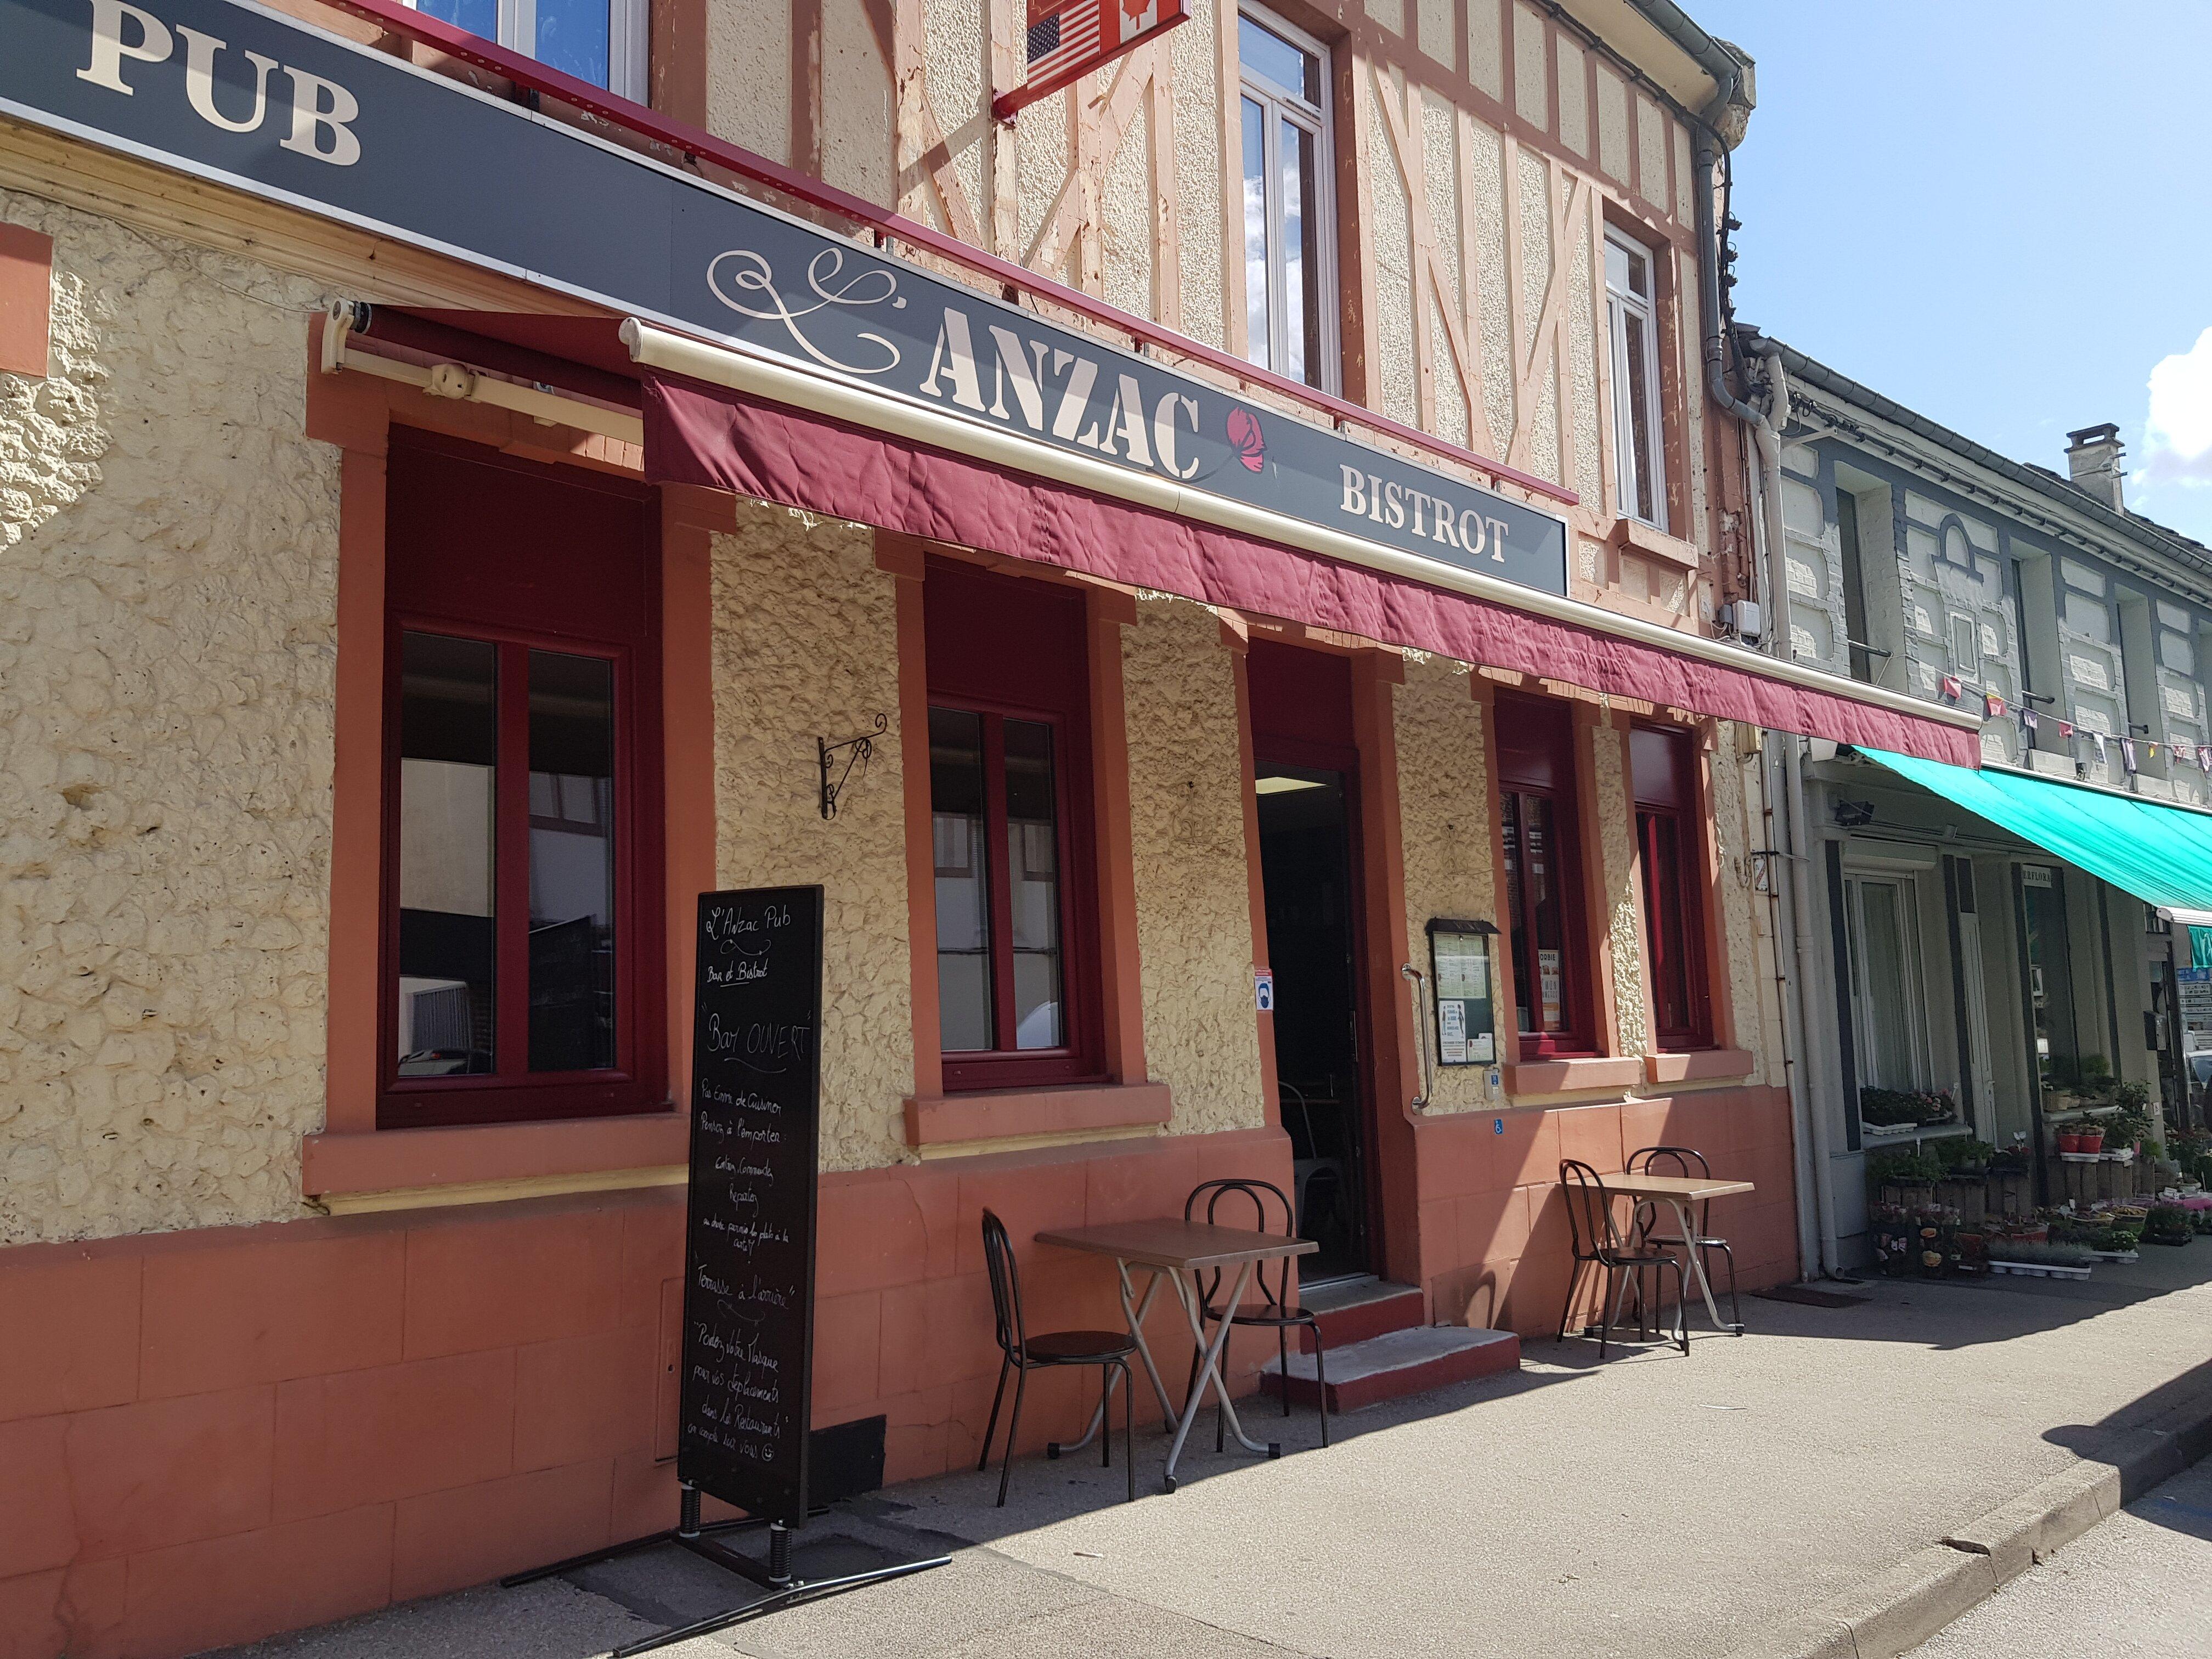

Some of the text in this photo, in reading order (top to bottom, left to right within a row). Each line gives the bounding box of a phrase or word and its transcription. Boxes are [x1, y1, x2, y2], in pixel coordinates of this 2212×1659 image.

[76, 0, 361, 167] PUB
[706, 247, 1199, 479] L'ANZAC
[1339, 464, 1509, 563] BISTROT
[2023, 870, 2051, 882] ERFLORA
[764, 904, 791, 929] Pub
[707, 957, 769, 983] Bar et Bistrot
[701, 1077, 712, 1099] Pas
[735, 1090, 747, 1108] de
[701, 1110, 725, 1144] Pensez
[747, 1332, 780, 1380] Masque
